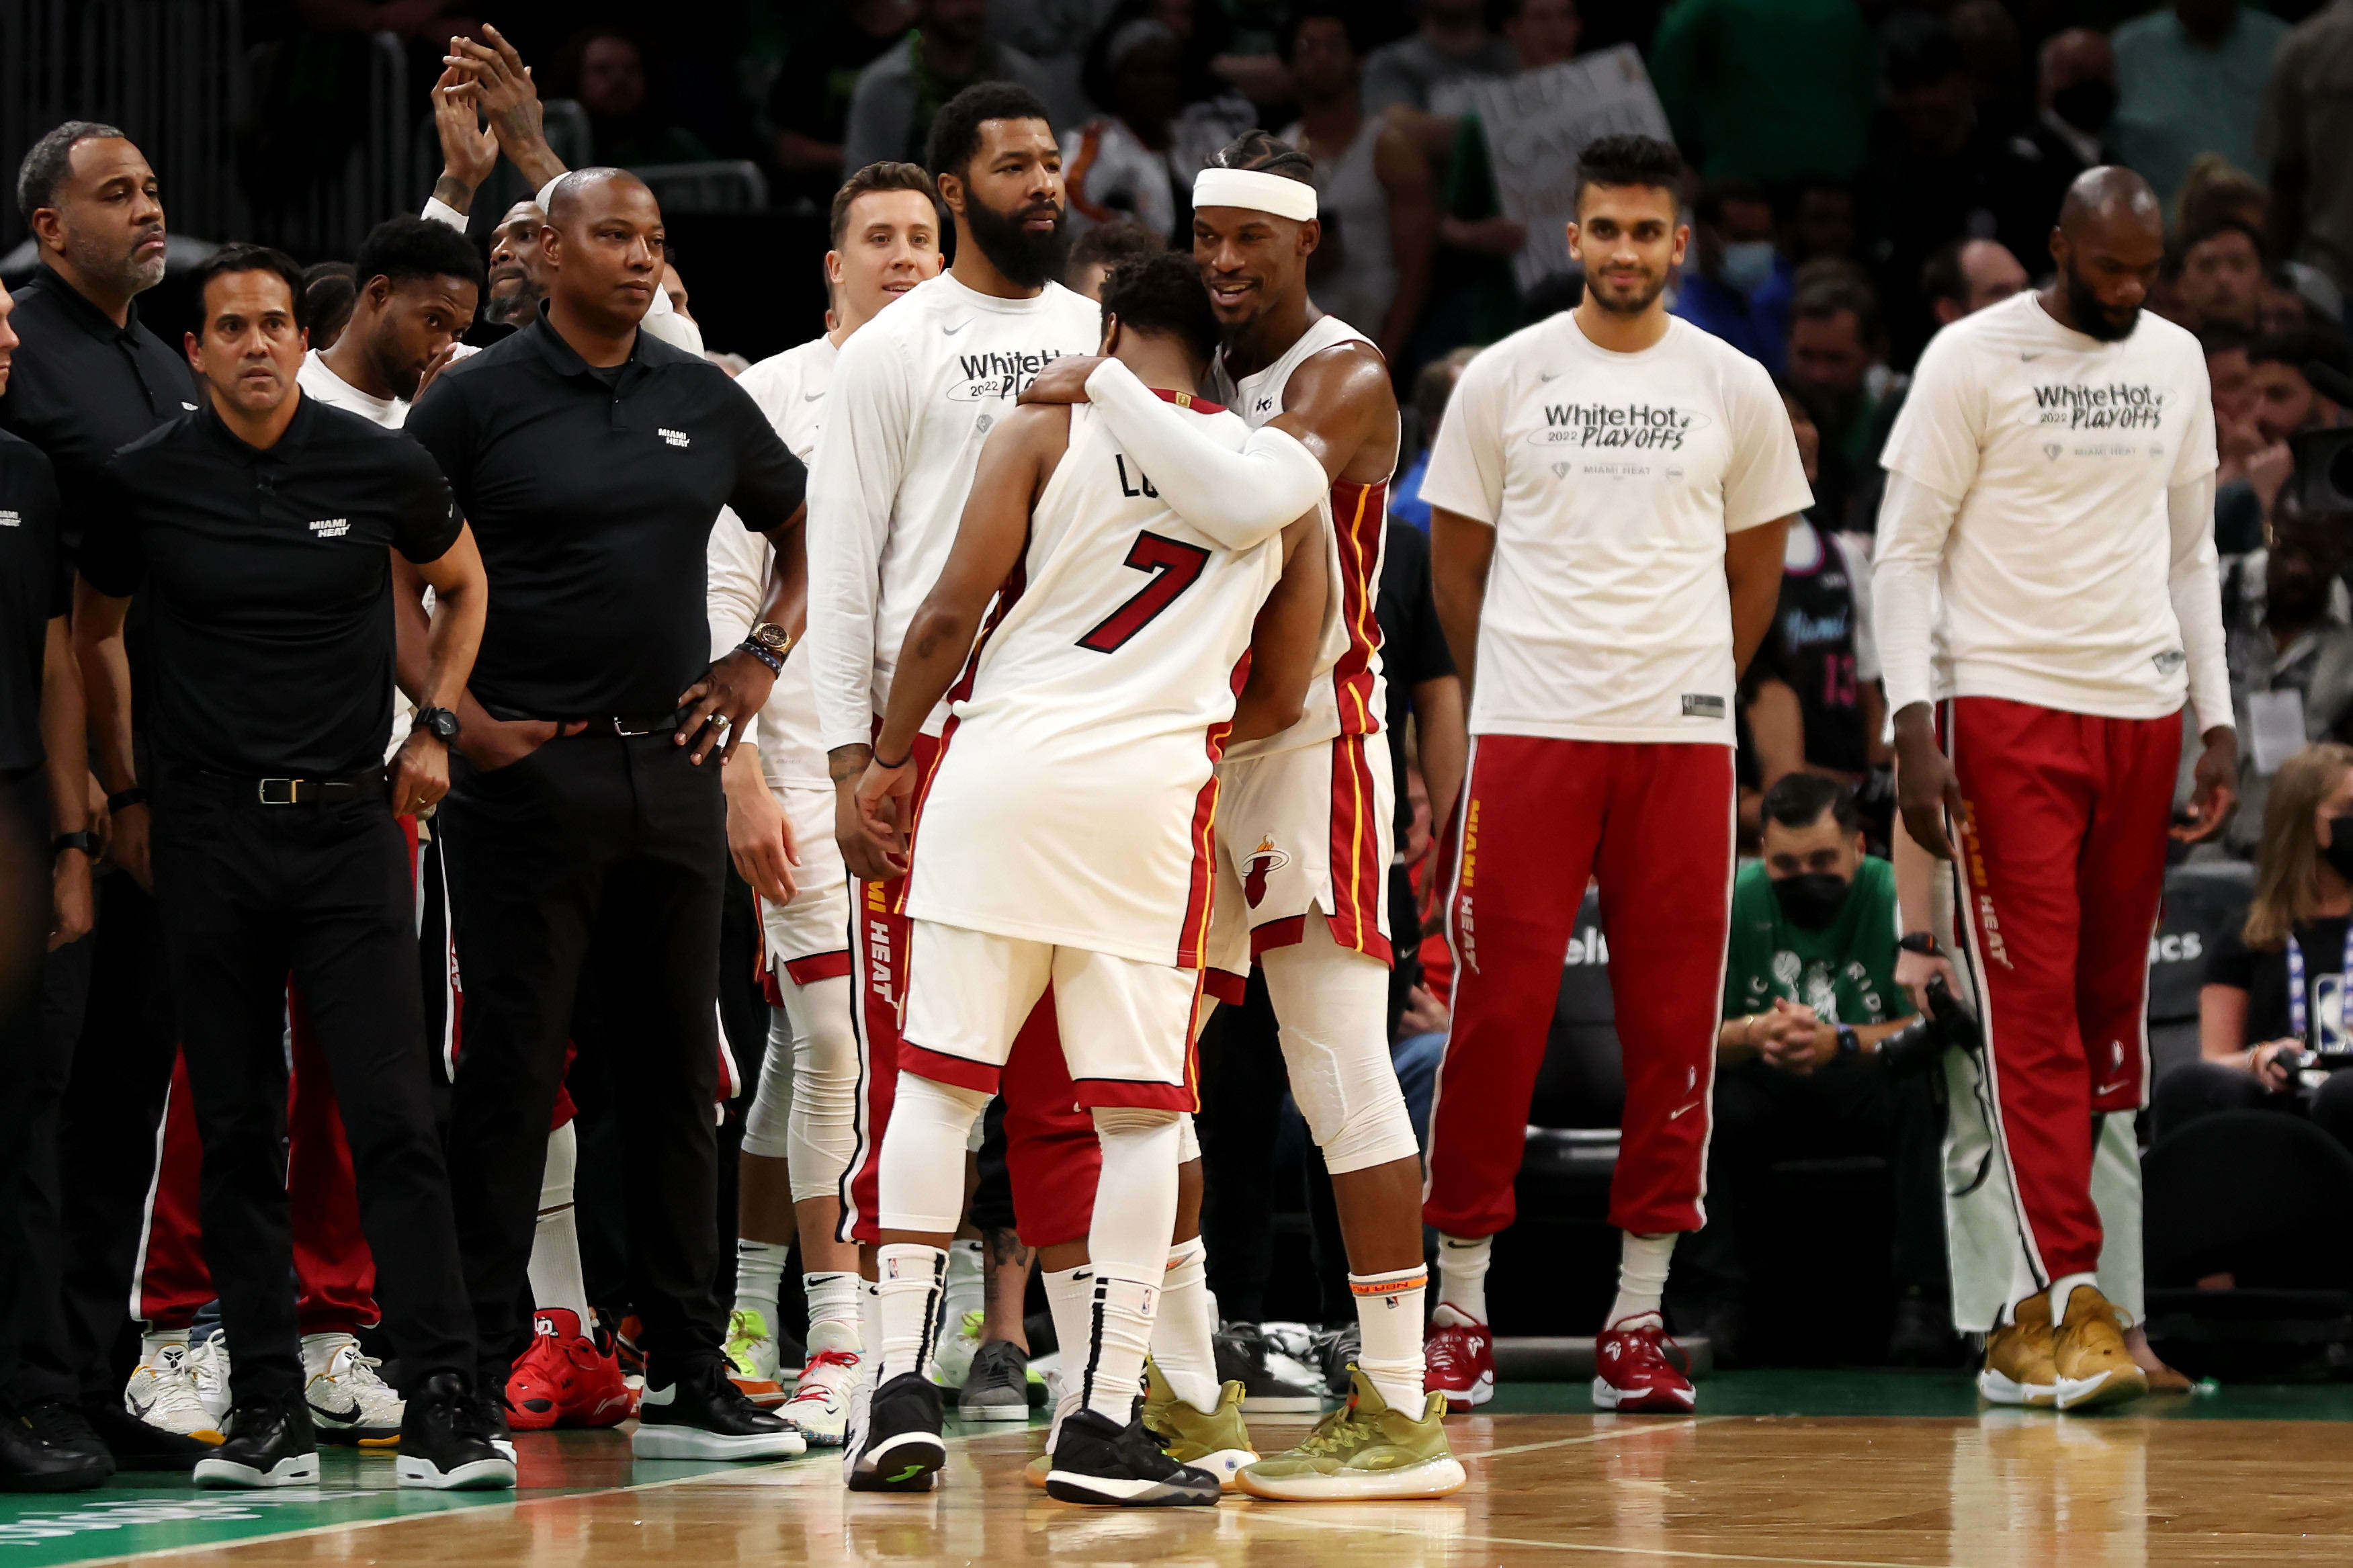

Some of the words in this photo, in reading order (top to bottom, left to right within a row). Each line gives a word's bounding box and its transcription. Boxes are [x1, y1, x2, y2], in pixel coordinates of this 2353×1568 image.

[970, 381, 998, 396] 2022
[658, 428, 686, 440] MIAMI
[1548, 431, 1578, 441] 2022
[666, 437, 690, 447] HEAT
[1584, 466, 1619, 474] MIAMI
[1621, 466, 1651, 475] HEAT
[309, 519, 347, 530] MIAMI
[317, 523, 351, 537] HEAT
[1074, 529, 1213, 654] 7
[1462, 799, 1480, 887] MIAMI
[1461, 894, 1480, 975] HEAT
[1980, 894, 2014, 970] HEAT
[870, 920, 900, 1010] HEAT
